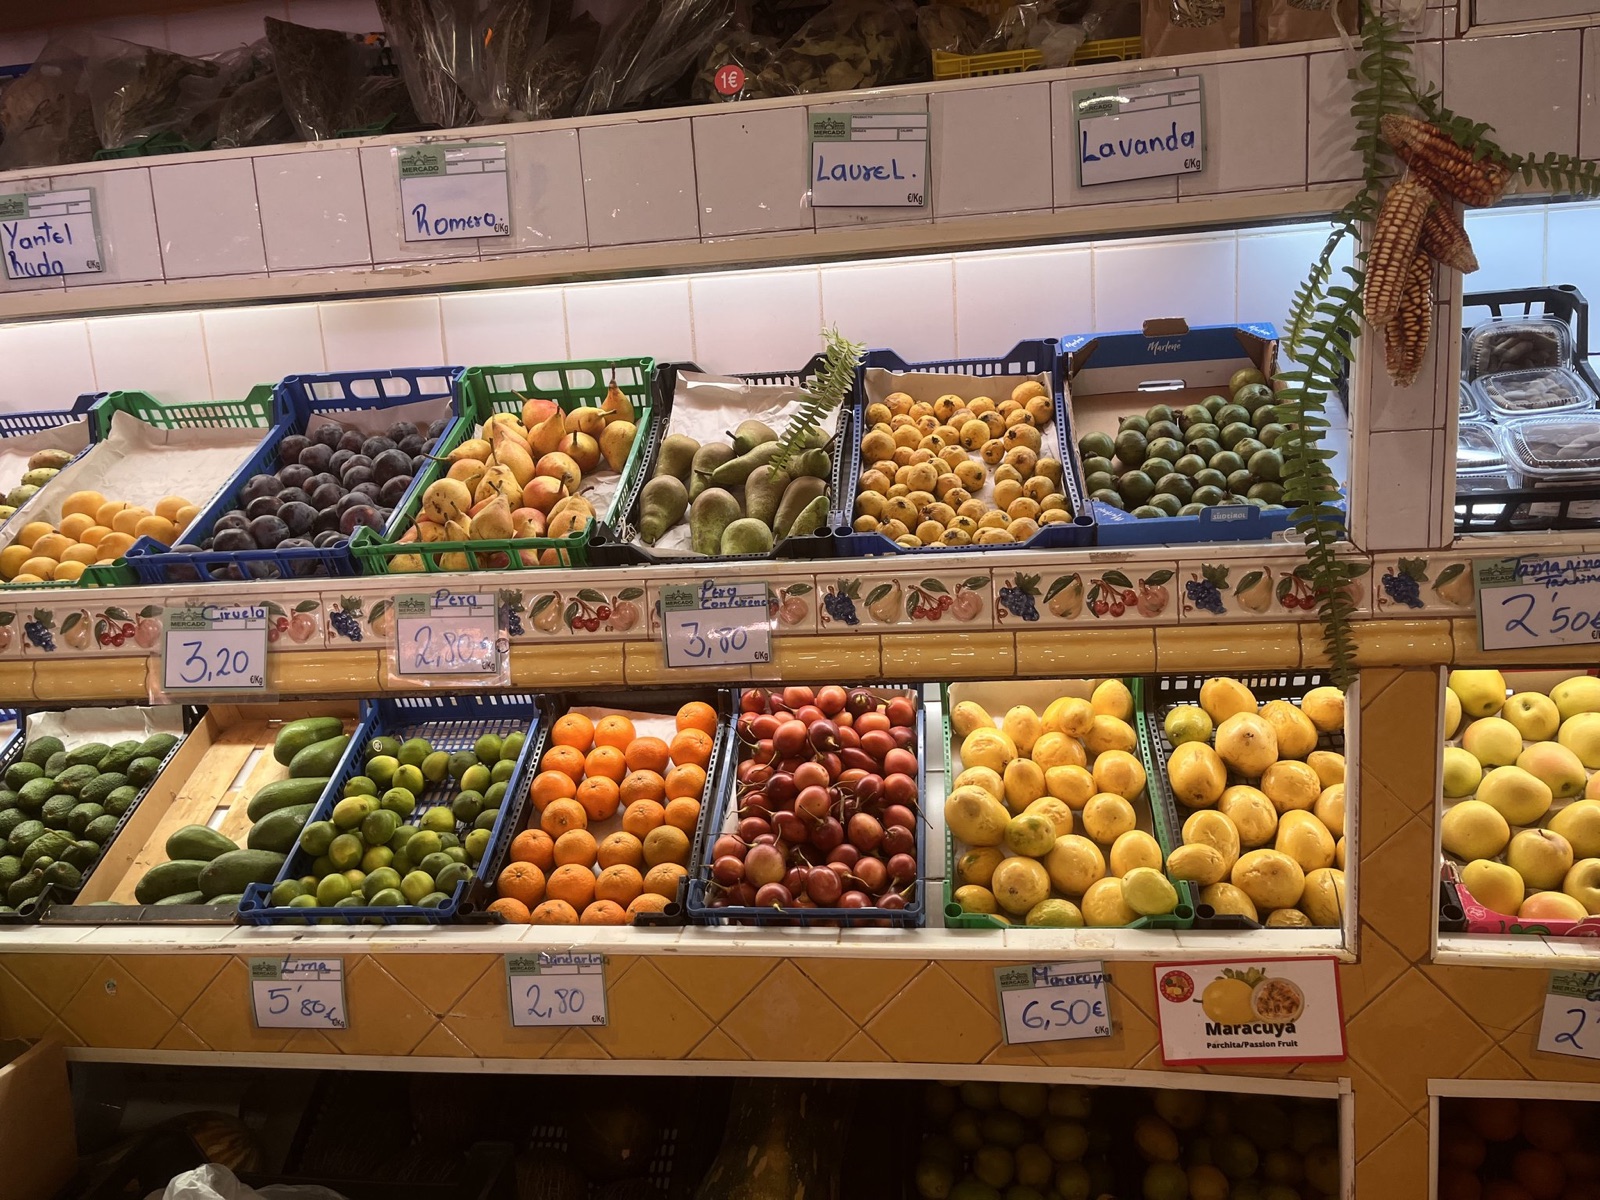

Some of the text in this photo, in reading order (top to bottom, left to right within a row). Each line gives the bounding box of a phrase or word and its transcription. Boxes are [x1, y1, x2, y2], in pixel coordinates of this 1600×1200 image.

[721, 71, 738, 88] 1€
[1083, 121, 1195, 163] Lavanda
[402, 165, 439, 173] MERCADO
[1184, 158, 1200, 169] €/Kg
[907, 193, 923, 204] €/Kg
[494, 222, 508, 234] €/Kg
[435, 589, 477, 608] Pera
[202, 605, 265, 620] Ciruela
[180, 641, 249, 683] 3,20
[754, 651, 769, 662] €/Kg
[250, 675, 263, 686] €/Kg
[281, 954, 331, 973] Lima
[527, 985, 584, 1018] 2,80
[592, 1015, 605, 1024] €/Kg
[1095, 1026, 1109, 1035] €/Kg
[1206, 1040, 1298, 1049] Parchita/Passion Fruit
